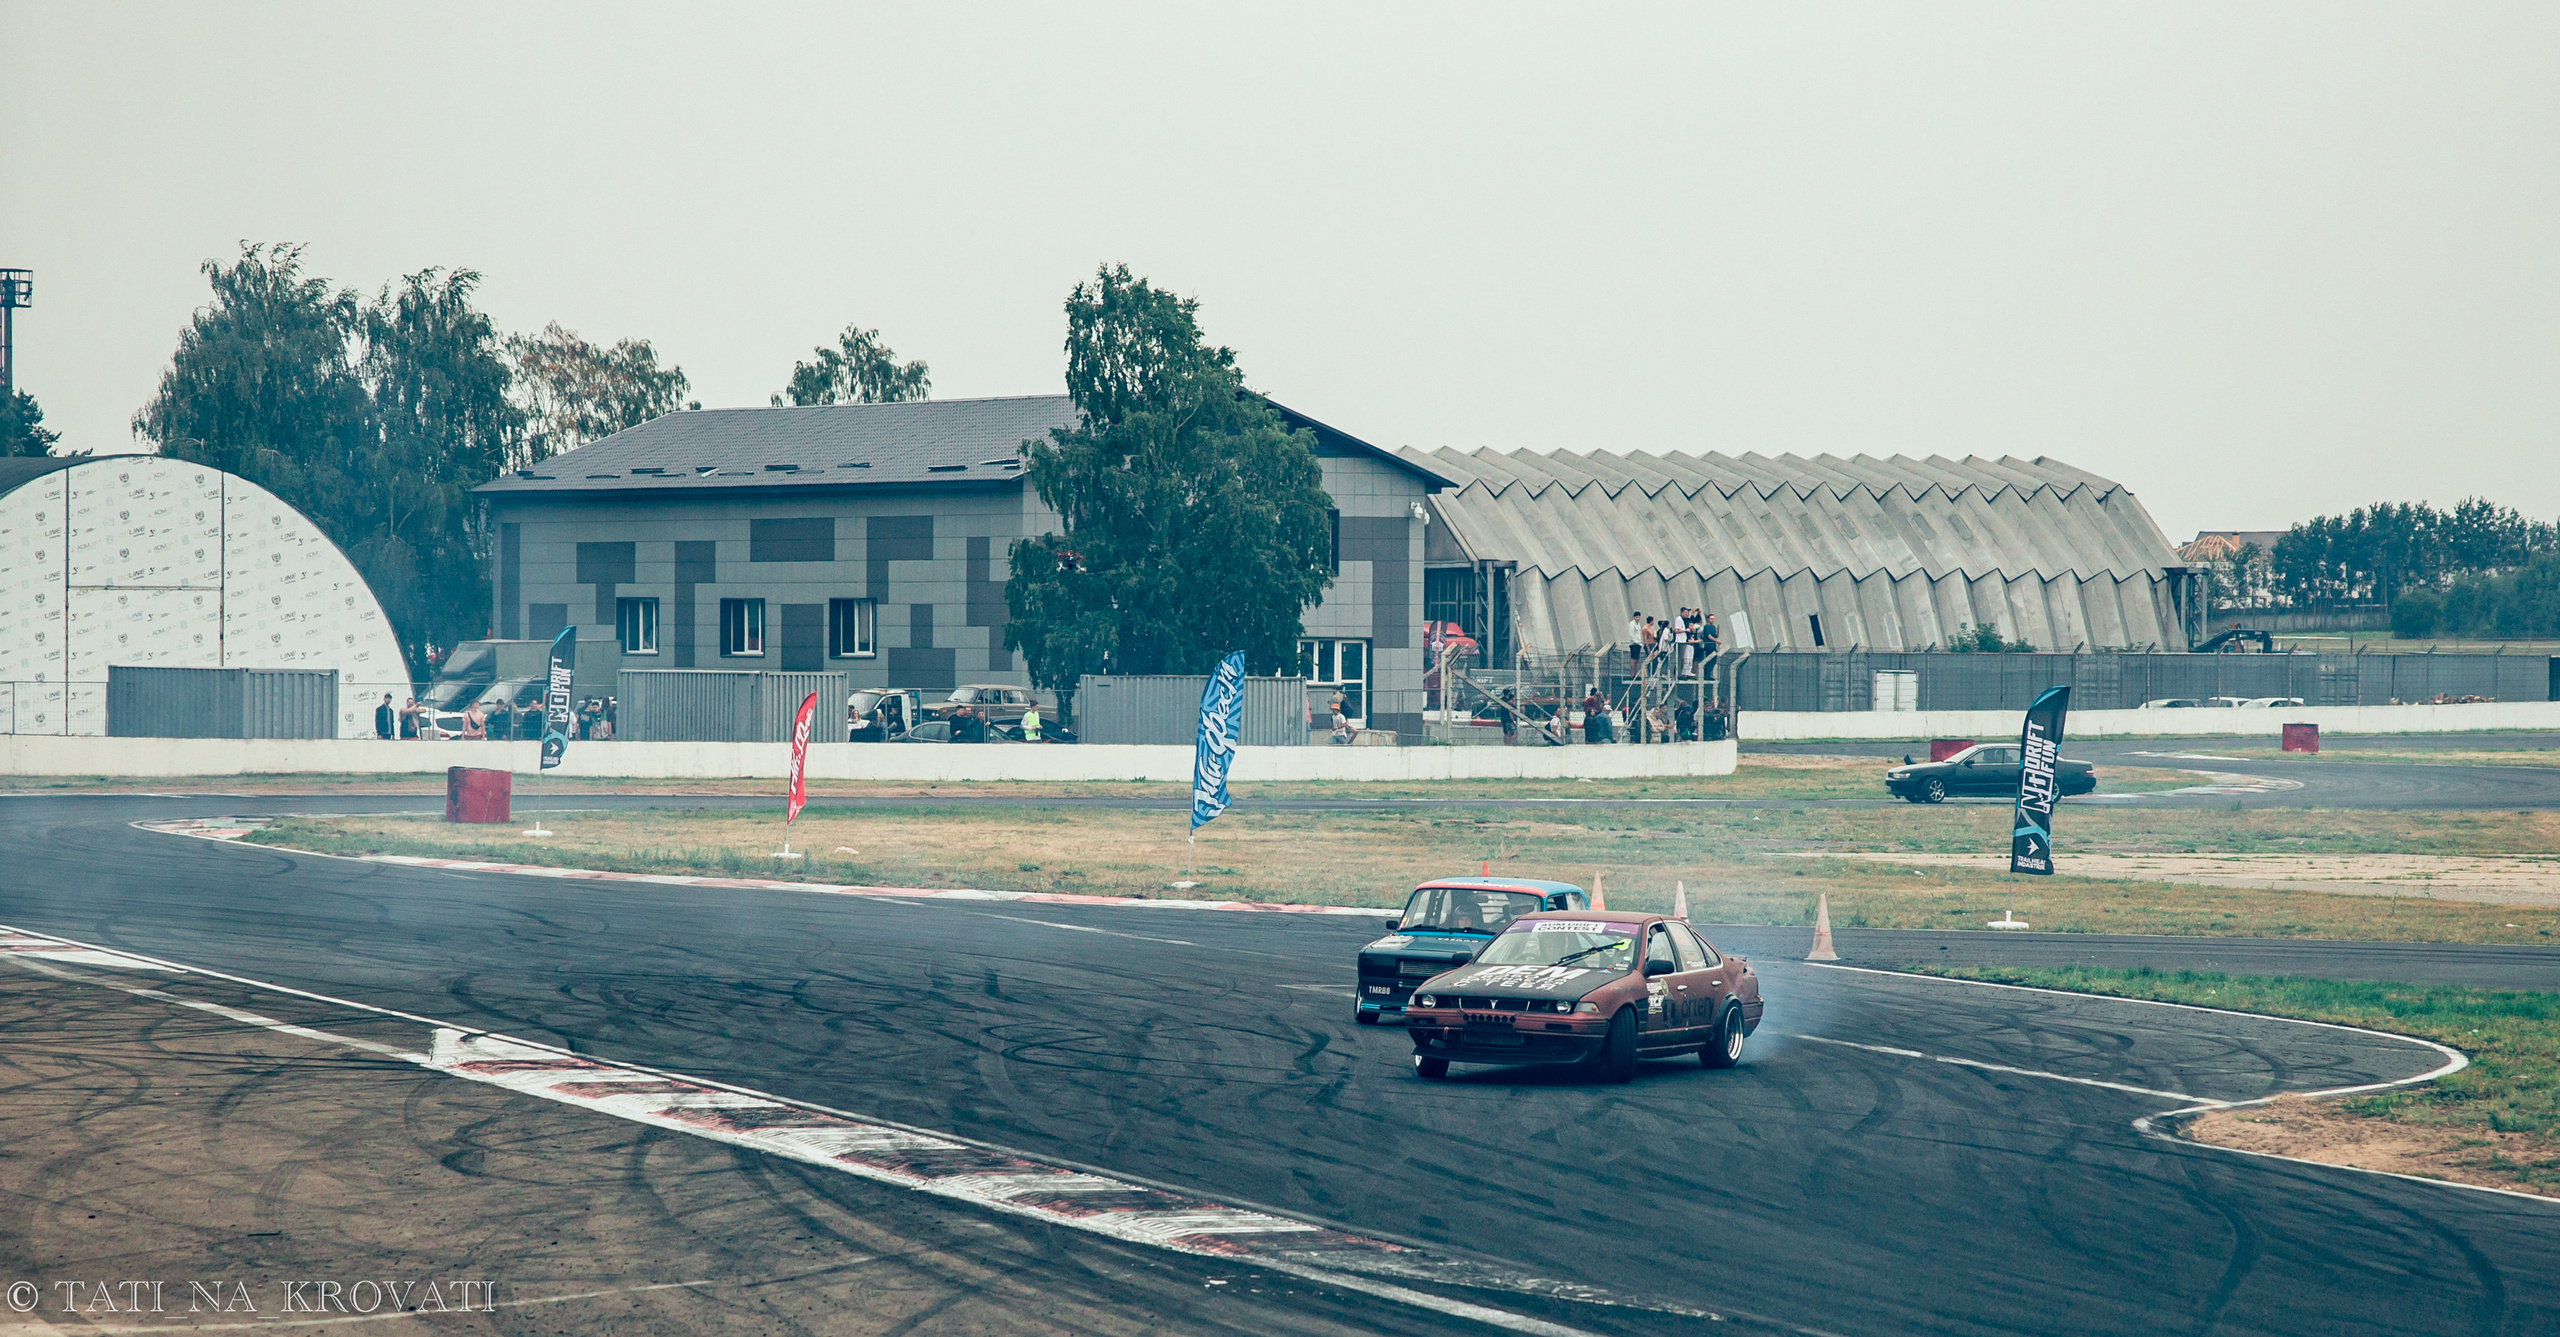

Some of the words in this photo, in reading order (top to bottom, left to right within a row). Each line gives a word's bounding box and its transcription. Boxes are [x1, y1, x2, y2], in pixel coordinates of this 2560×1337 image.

[550, 656, 562, 692] DRIFT
[560, 668, 571, 692] FUN
[2024, 720, 2045, 770] DRIFT
[2040, 739, 2056, 774] FUN
[1474, 965, 1590, 980] DEM
[1368, 986, 1391, 995] TMR88
